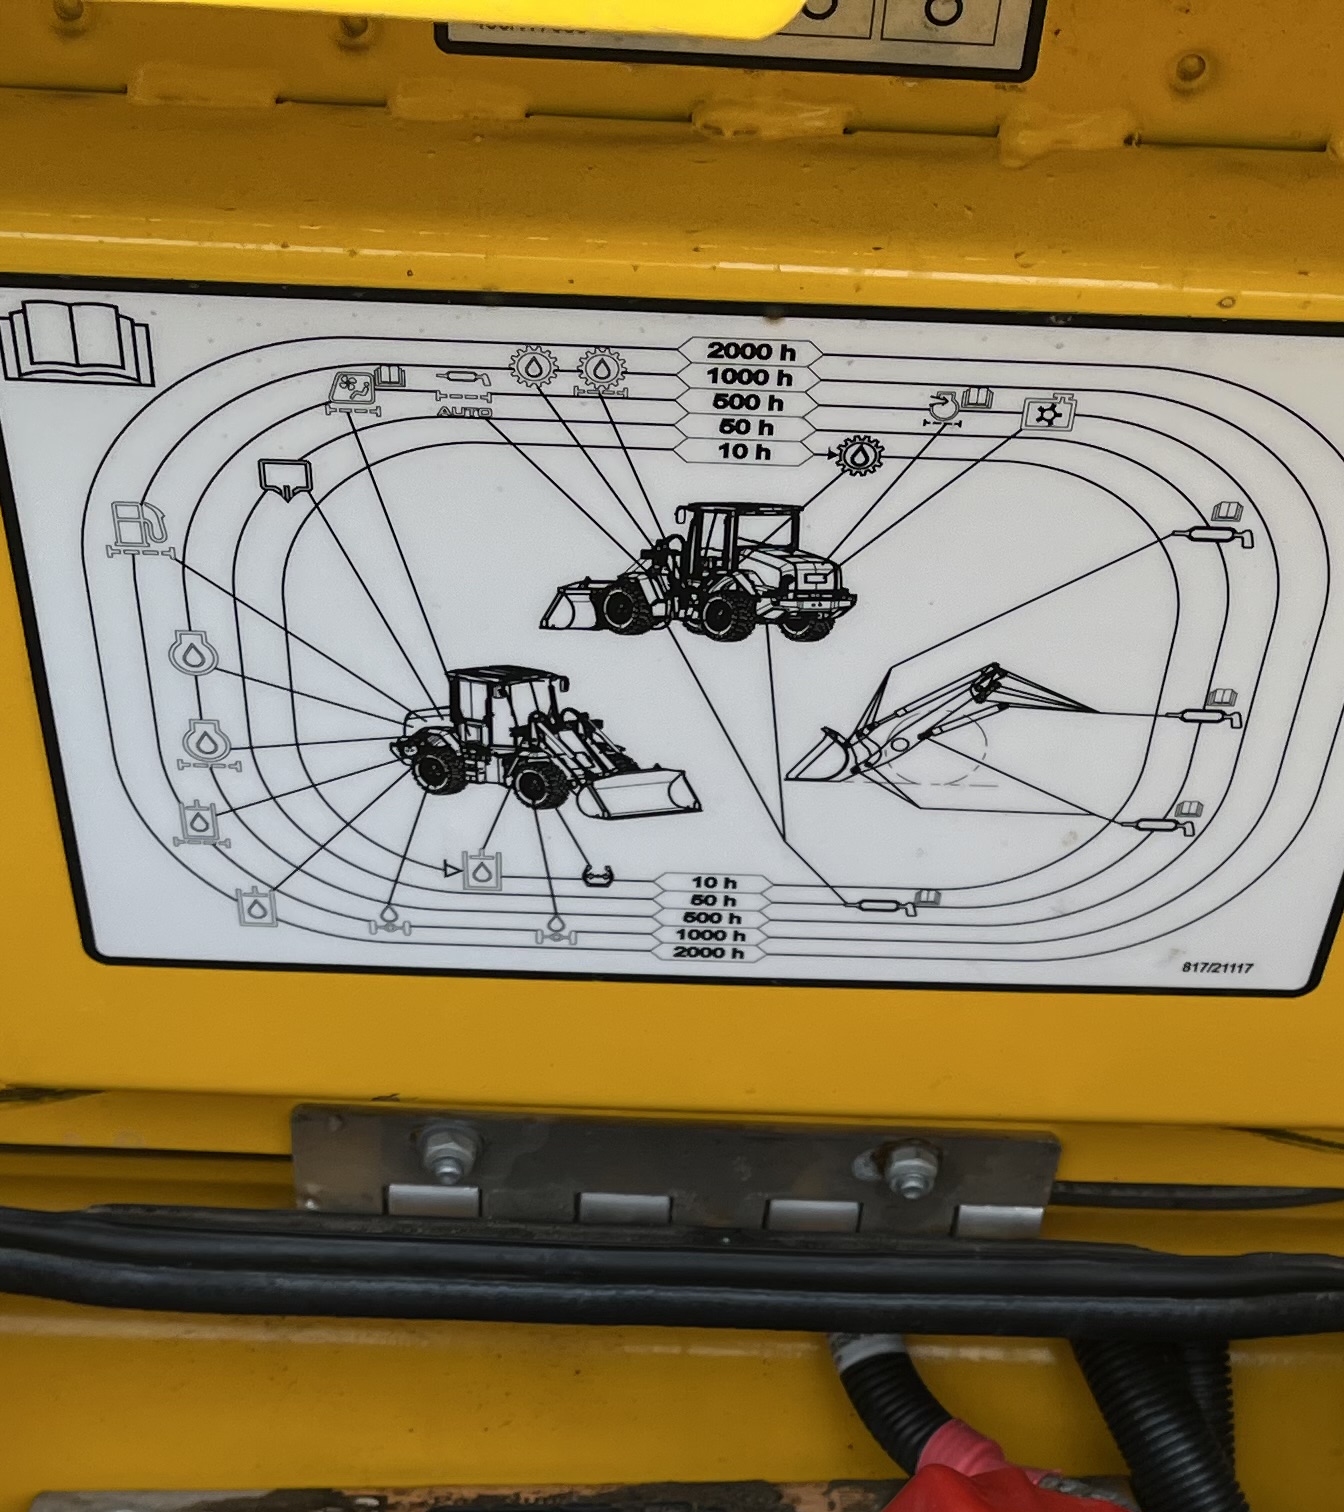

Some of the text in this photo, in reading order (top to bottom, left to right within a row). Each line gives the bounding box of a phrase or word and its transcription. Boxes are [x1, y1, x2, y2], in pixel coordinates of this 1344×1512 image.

[707, 342, 796, 361] 2000 h
[707, 367, 793, 386] 1000 h
[712, 393, 784, 411] 500 h
[437, 405, 493, 418] AUTO
[719, 418, 774, 436] 50 h
[718, 443, 771, 461] 10 h
[692, 876, 737, 890] 10 h
[690, 894, 737, 907] 50 h
[683, 912, 742, 925] 500 h
[676, 929, 746, 942] 1000 h
[673, 946, 745, 959] 2000 h
[1181, 962, 1254, 974] 817/21117
